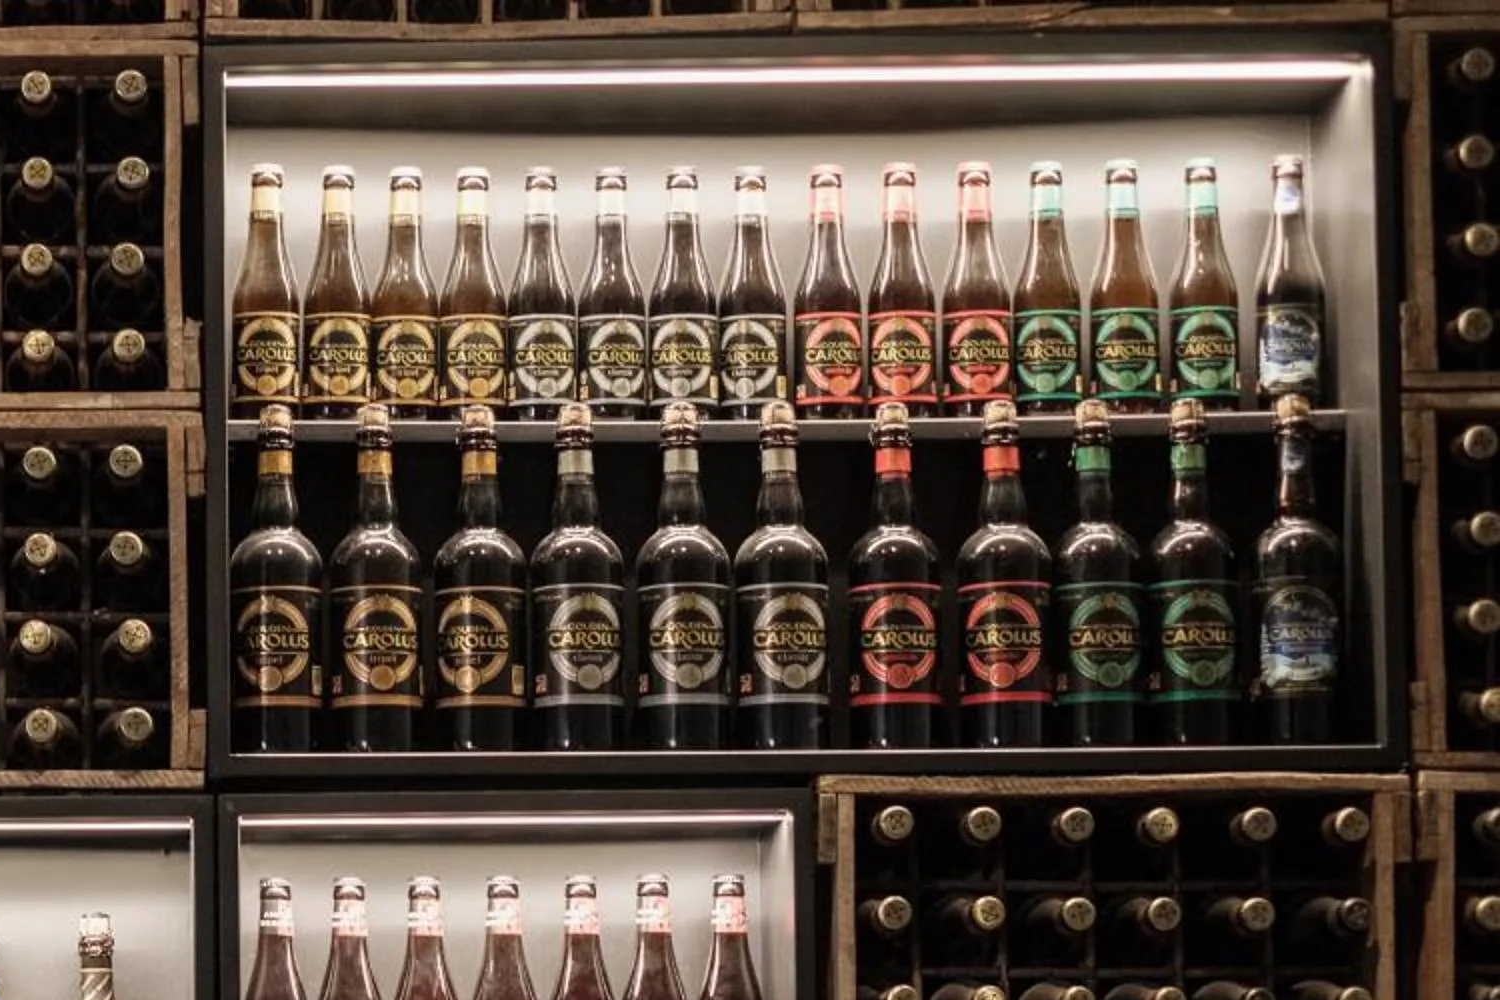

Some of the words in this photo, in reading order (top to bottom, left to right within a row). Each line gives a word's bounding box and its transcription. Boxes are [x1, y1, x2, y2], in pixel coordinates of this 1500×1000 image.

[242, 633, 309, 651] AROLUS
[343, 634, 418, 651] CAROLUS
[440, 632, 509, 651] AROLUS
[650, 632, 725, 649] CAROLUS
[861, 632, 936, 649] CAROLUS
[966, 629, 1041, 647] CAROLUS
[1069, 630, 1141, 648] CAROLU
